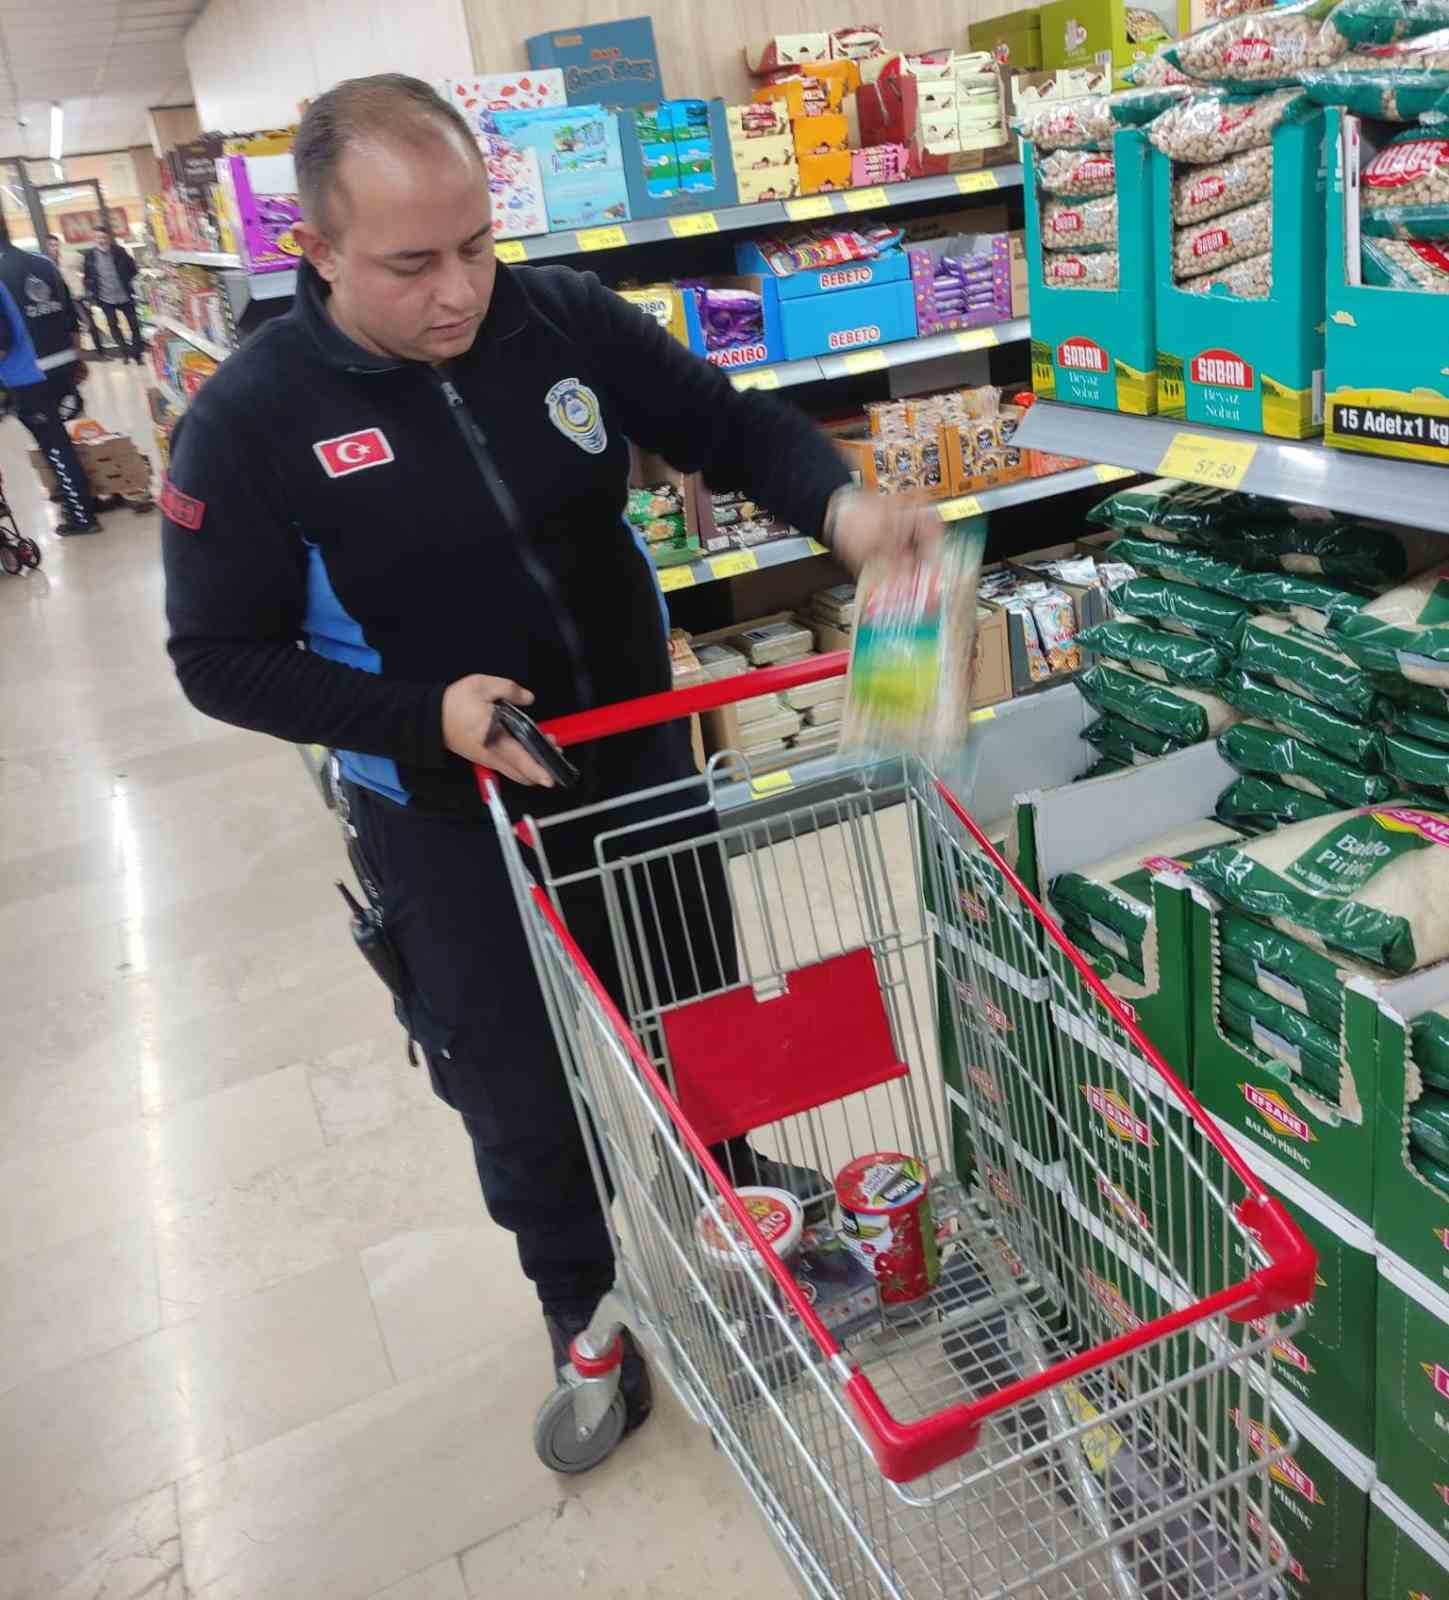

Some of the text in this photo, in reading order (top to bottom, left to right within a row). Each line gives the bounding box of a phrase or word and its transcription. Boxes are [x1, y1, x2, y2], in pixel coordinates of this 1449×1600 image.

[820, 266, 872, 289] BEBETO
[829, 326, 880, 349] BEBETO
[1063, 344, 1103, 370] SABAN
[1198, 357, 1246, 387] SABAN
[1339, 407, 1360, 430] 15
[1429, 418, 1449, 446] kg
